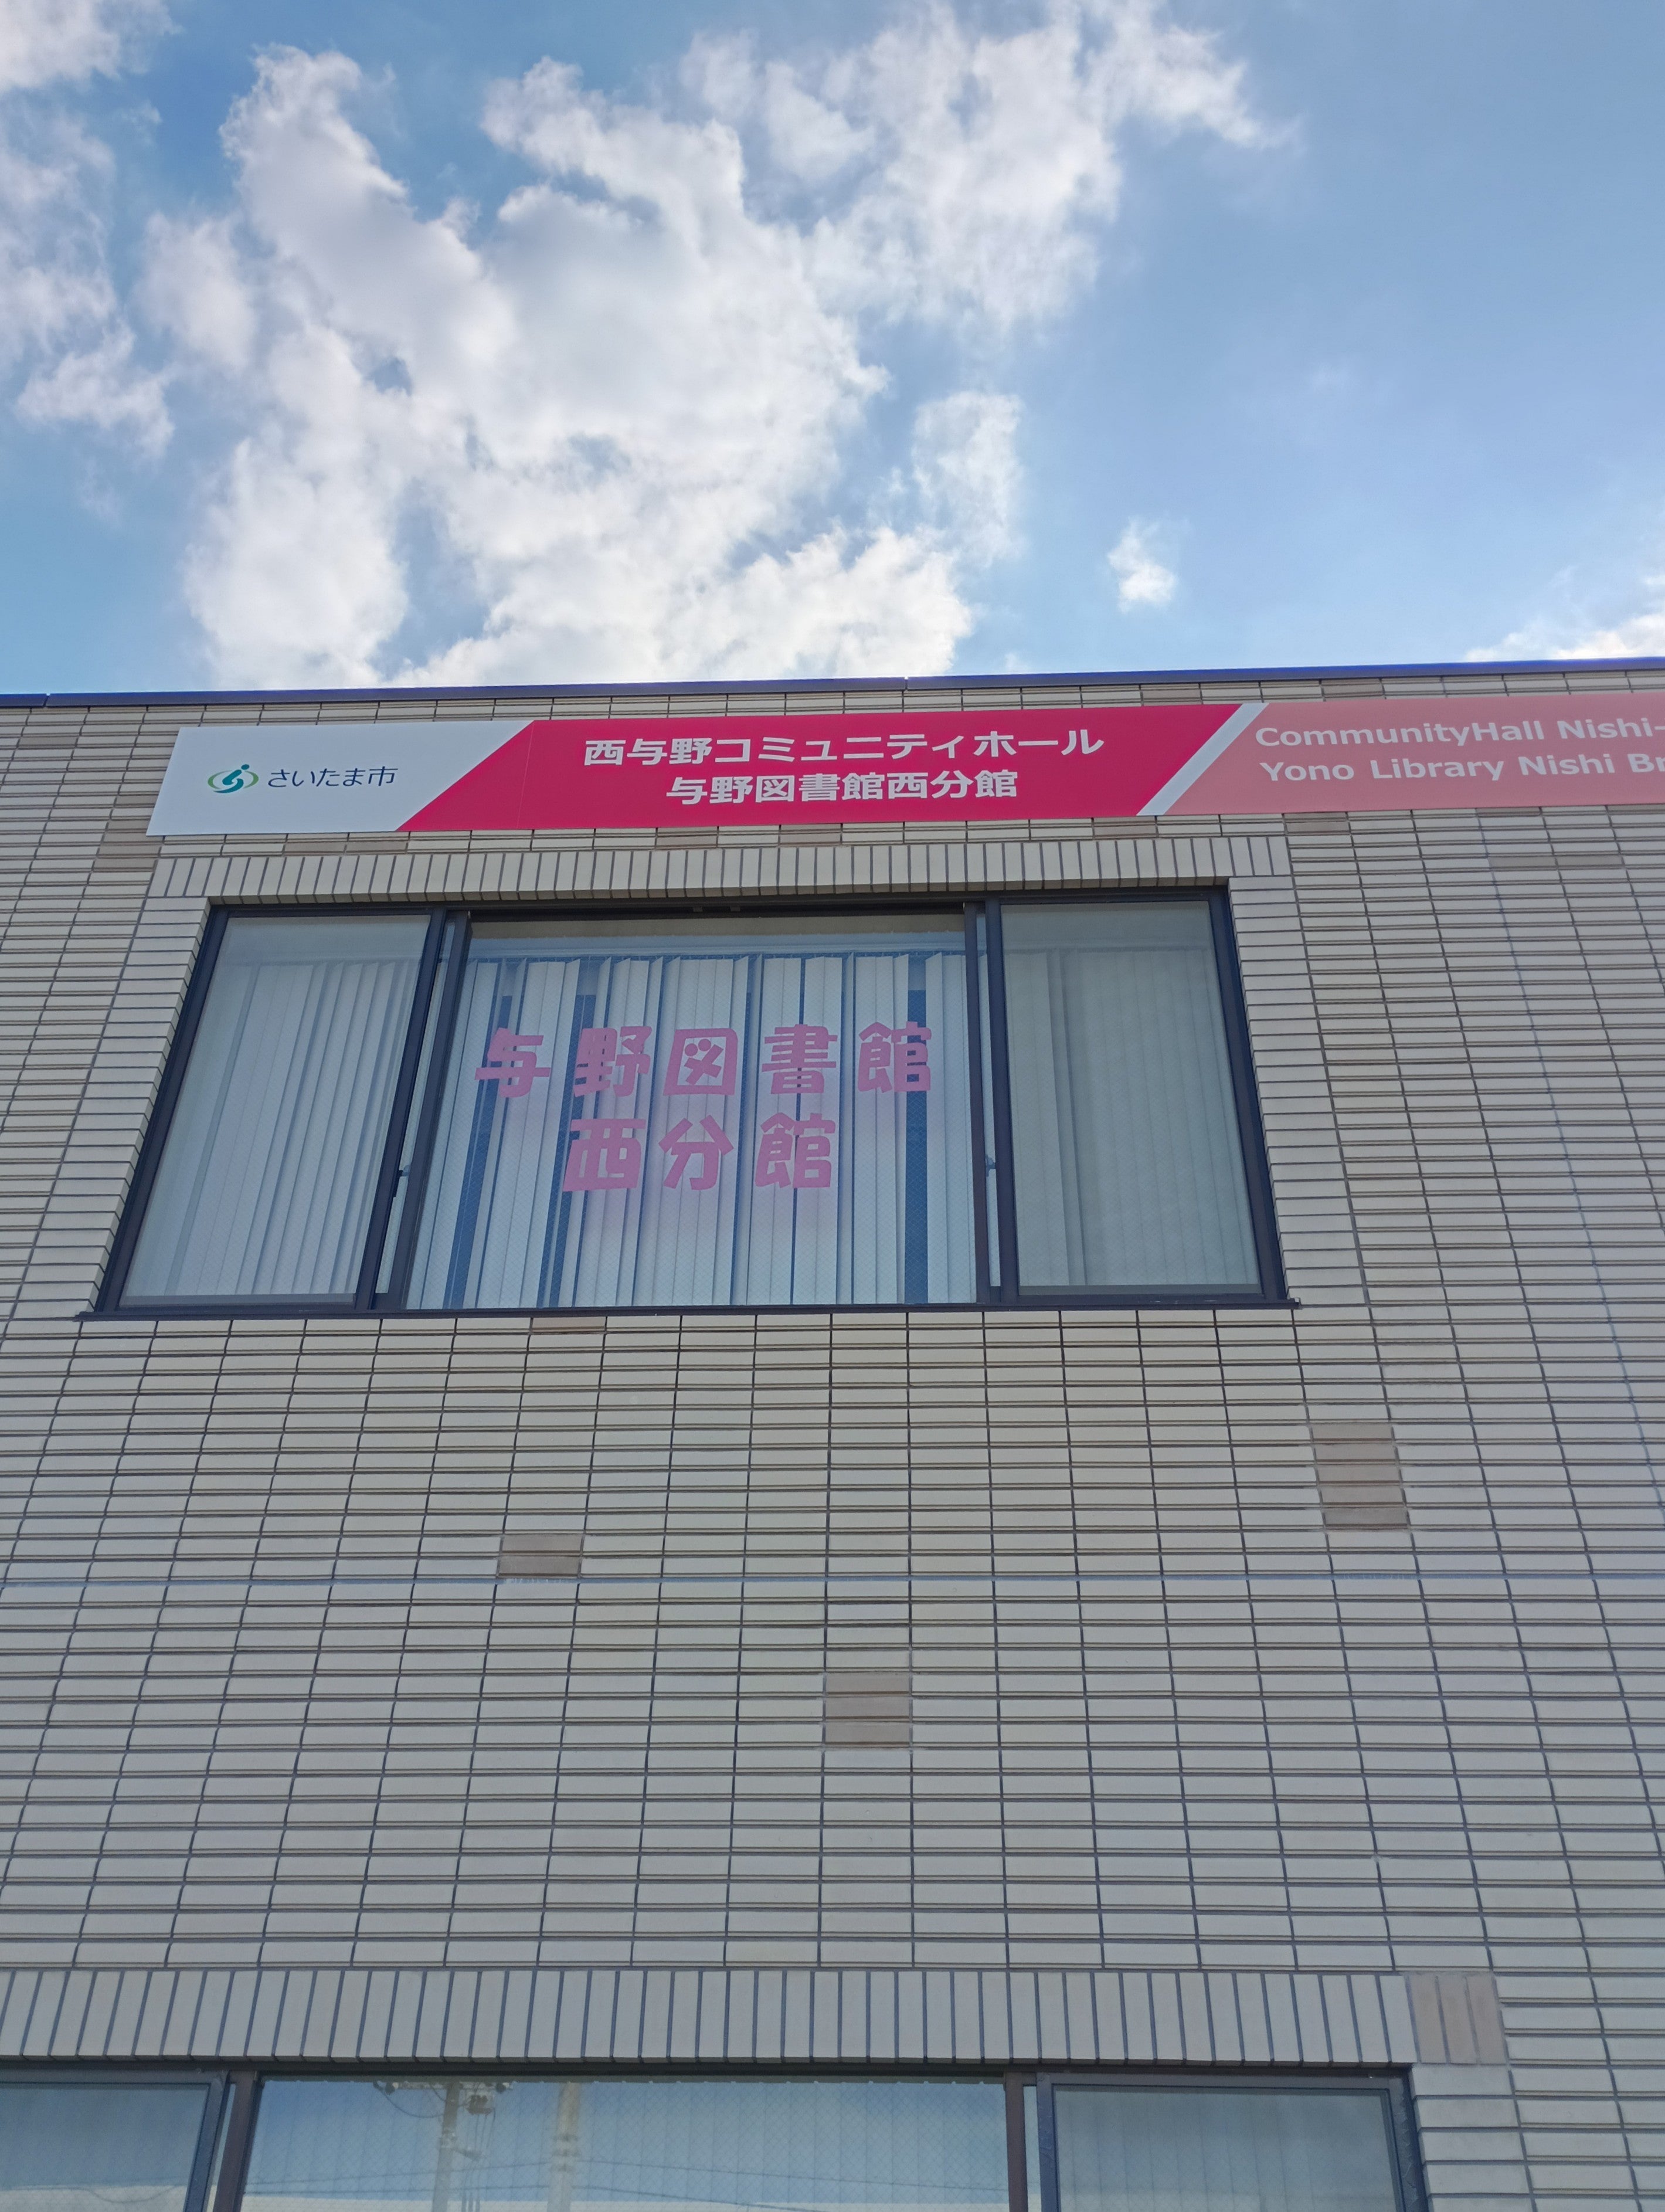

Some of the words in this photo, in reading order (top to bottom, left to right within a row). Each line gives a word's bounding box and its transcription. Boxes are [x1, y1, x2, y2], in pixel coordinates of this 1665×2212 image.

[584, 729, 1105, 766] 西与野コミュニティホール
[267, 766, 399, 788] さいたま市
[1259, 762, 1355, 782] Yono
[1370, 758, 1504, 781] Library
[1518, 753, 1615, 776] Nishi
[665, 769, 1018, 805] 与野図書館西分館
[474, 1021, 933, 1098] 与野図書館
[562, 1112, 837, 1192] 西分館
